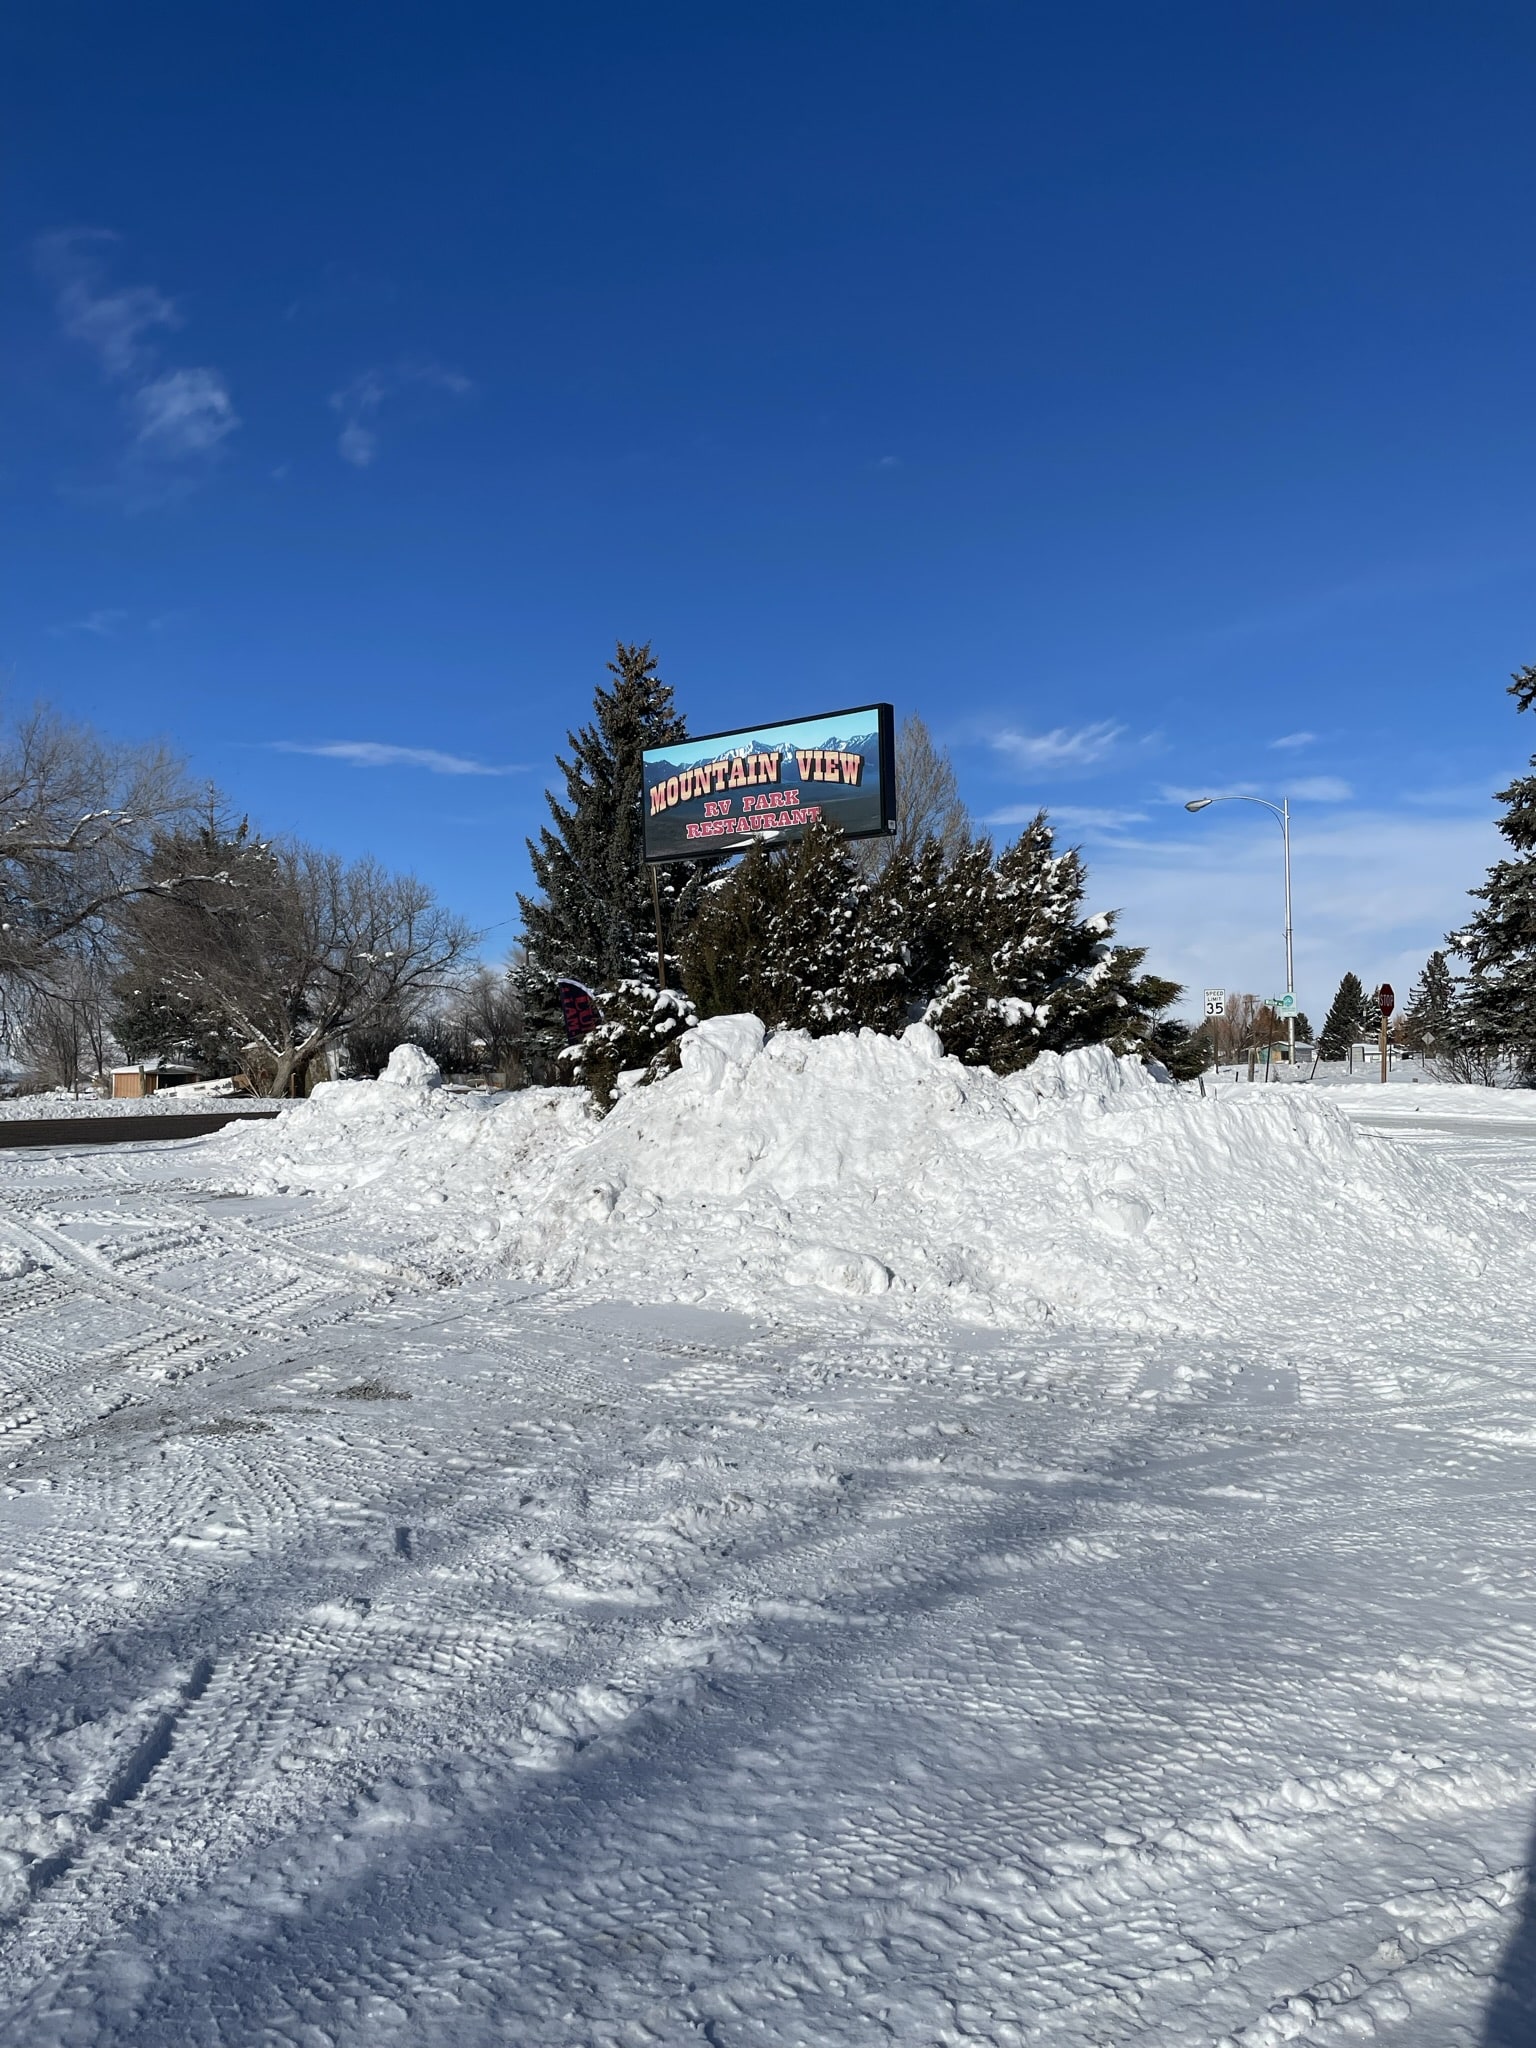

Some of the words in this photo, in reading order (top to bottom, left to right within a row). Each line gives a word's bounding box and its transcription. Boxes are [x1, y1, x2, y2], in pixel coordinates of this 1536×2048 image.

[650, 752, 781, 817] MOUNTAIN
[795, 750, 863, 786] VIEW
[704, 799, 732, 817] RV
[743, 789, 800, 812] PARK
[686, 806, 821, 839] RESTAURANT
[1206, 1002, 1224, 1015] 35
[1380, 993, 1393, 1007] STOP
